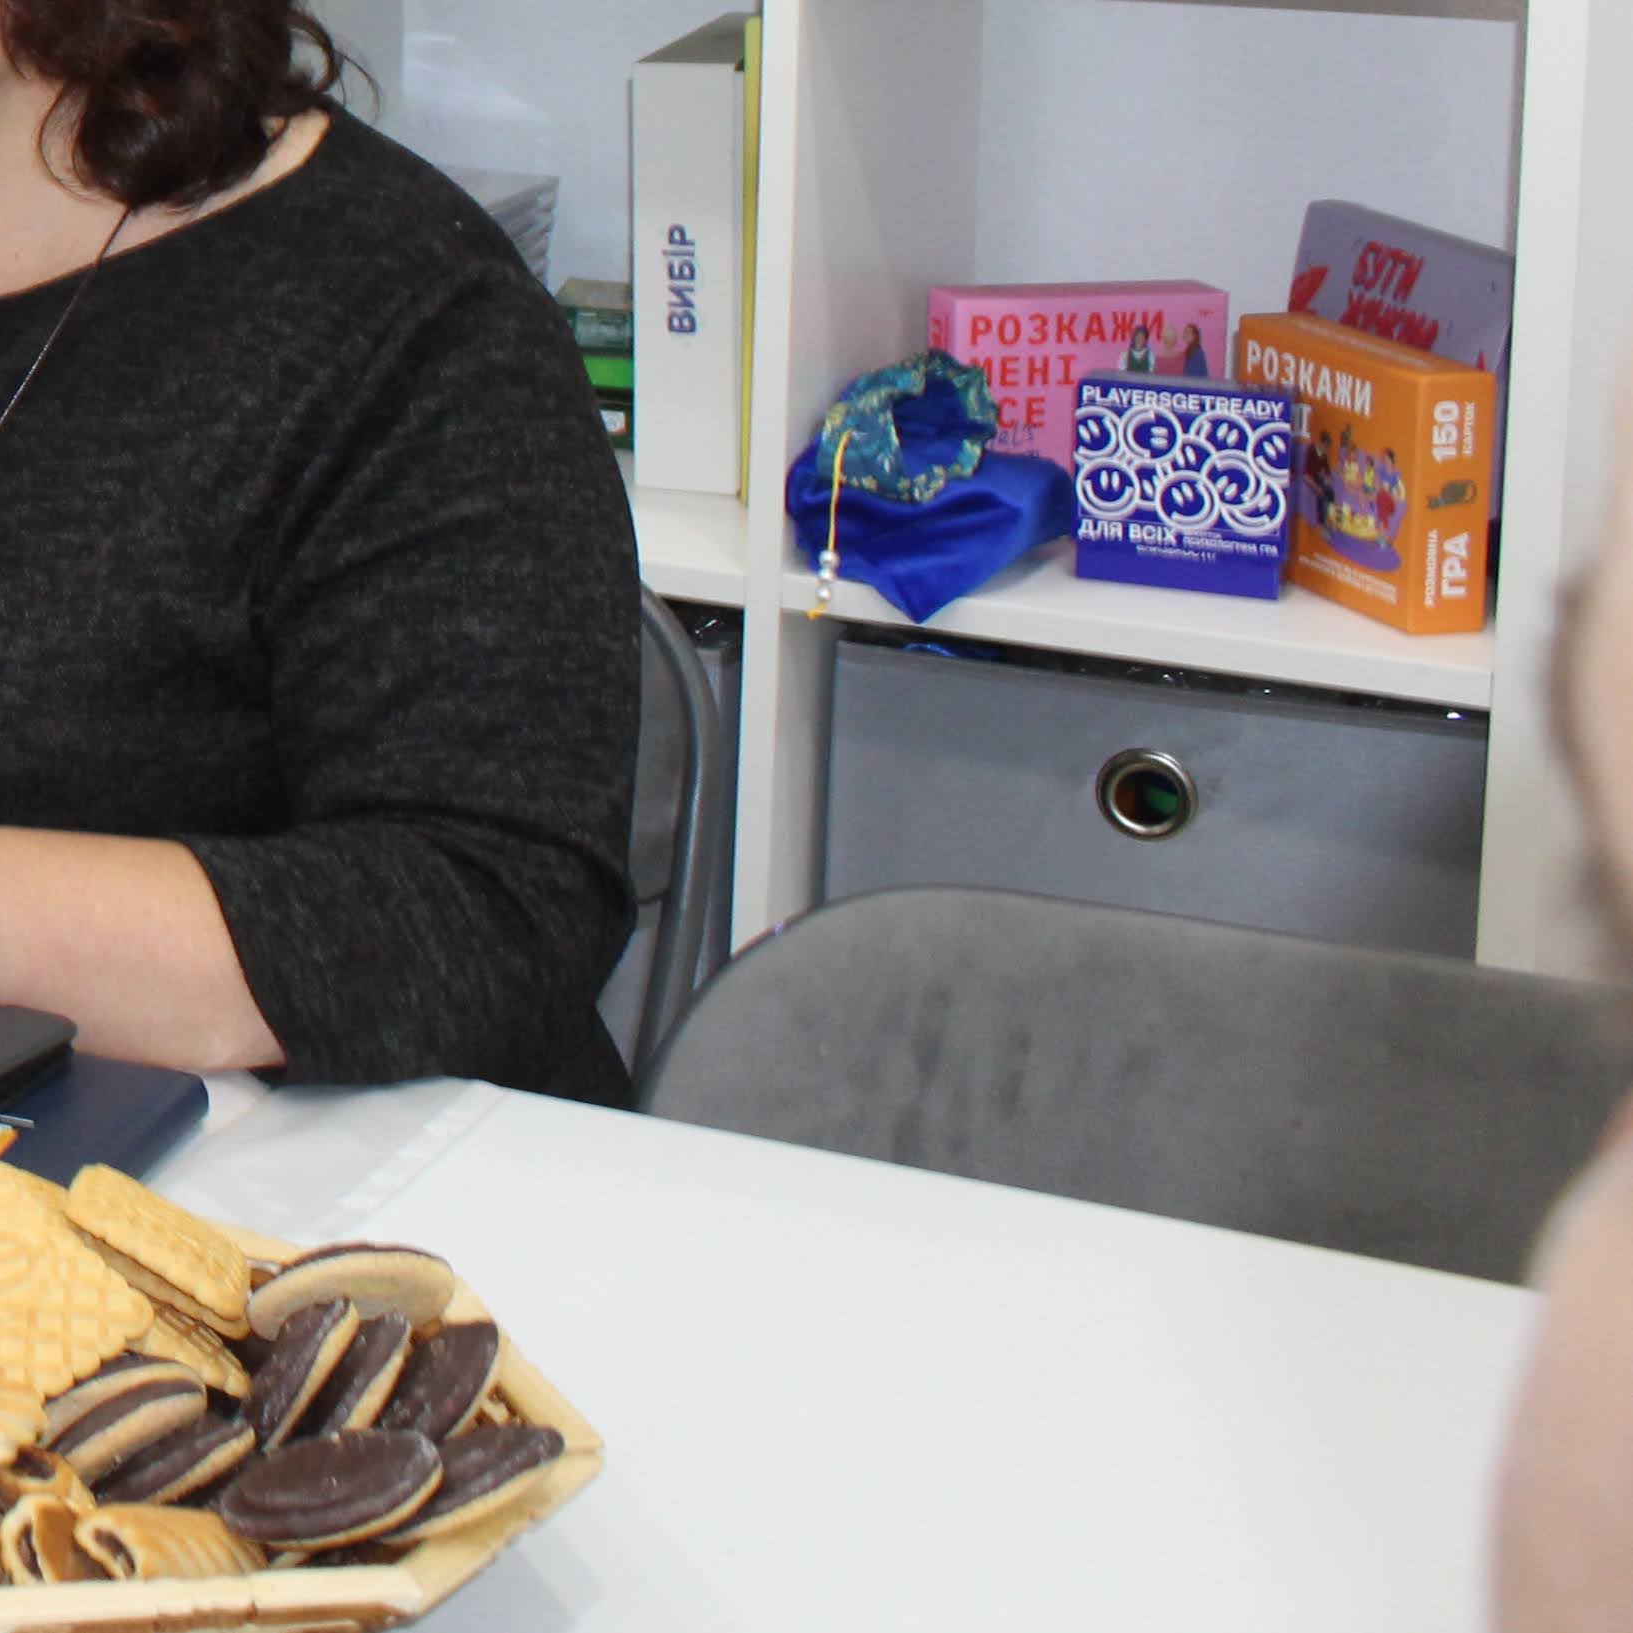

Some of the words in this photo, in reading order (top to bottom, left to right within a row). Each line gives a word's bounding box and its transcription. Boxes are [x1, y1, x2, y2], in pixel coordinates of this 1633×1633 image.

[664, 223, 696, 336] ВИБІР
[970, 309, 1165, 347] РОЗКАЖИ
[1246, 339, 1374, 418] РОЗКАЖИ
[998, 395, 1046, 430] СЕ
[1432, 399, 1461, 464] 150
[1078, 519, 1123, 542] ДЛЯ
[1128, 524, 1178, 547] ВСІХ
[1441, 531, 1471, 600] ГРА
